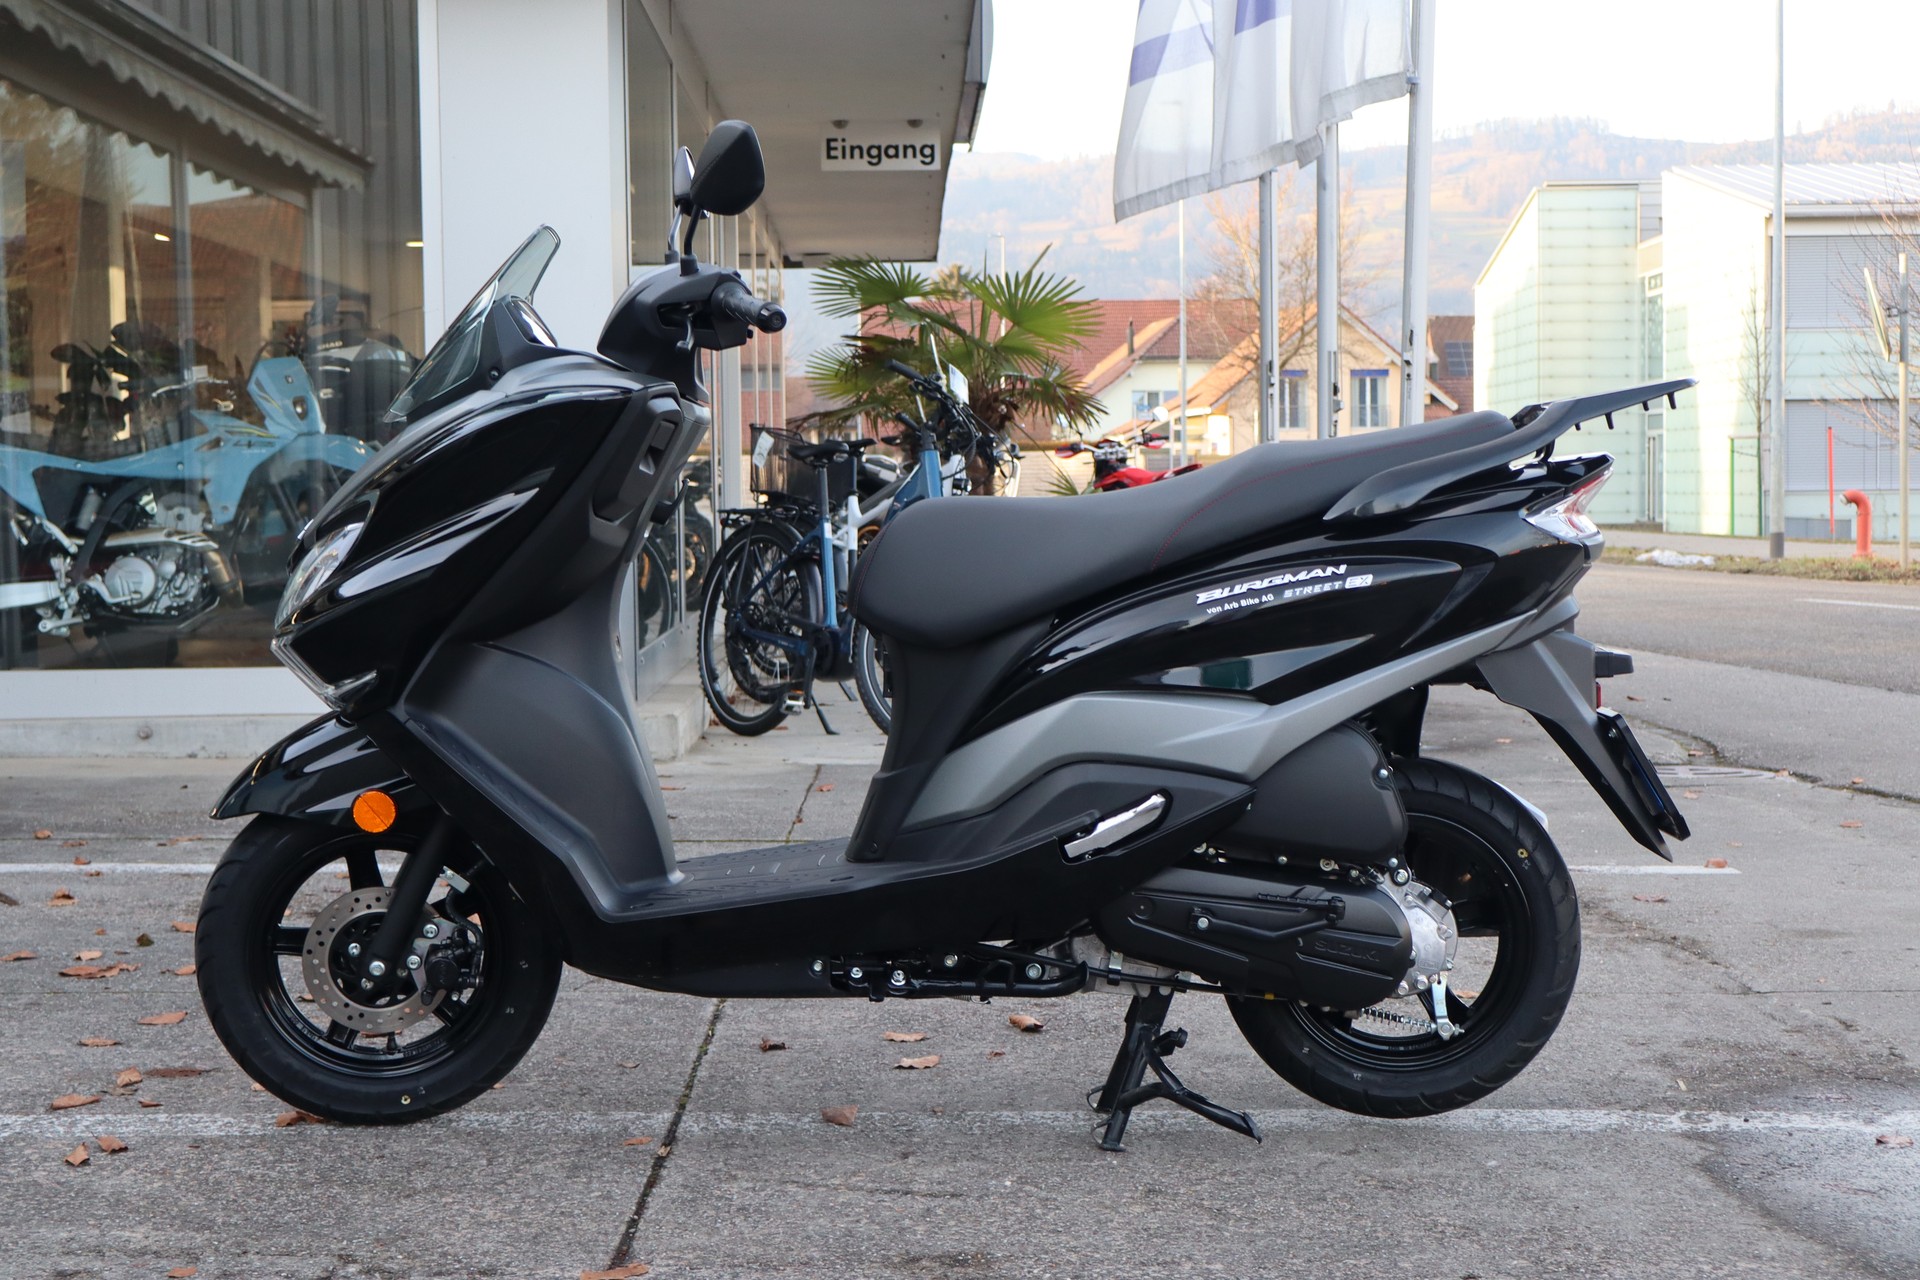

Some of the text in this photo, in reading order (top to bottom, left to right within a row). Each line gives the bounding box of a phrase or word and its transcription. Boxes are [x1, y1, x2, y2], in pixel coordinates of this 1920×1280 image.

[826, 138, 935, 166] Eingang
[1196, 564, 1347, 604] BURGMAN
[1283, 581, 1342, 598] STREET
[1206, 593, 1274, 614] von Arb Bike AG
[1314, 940, 1384, 962] SUZUK
